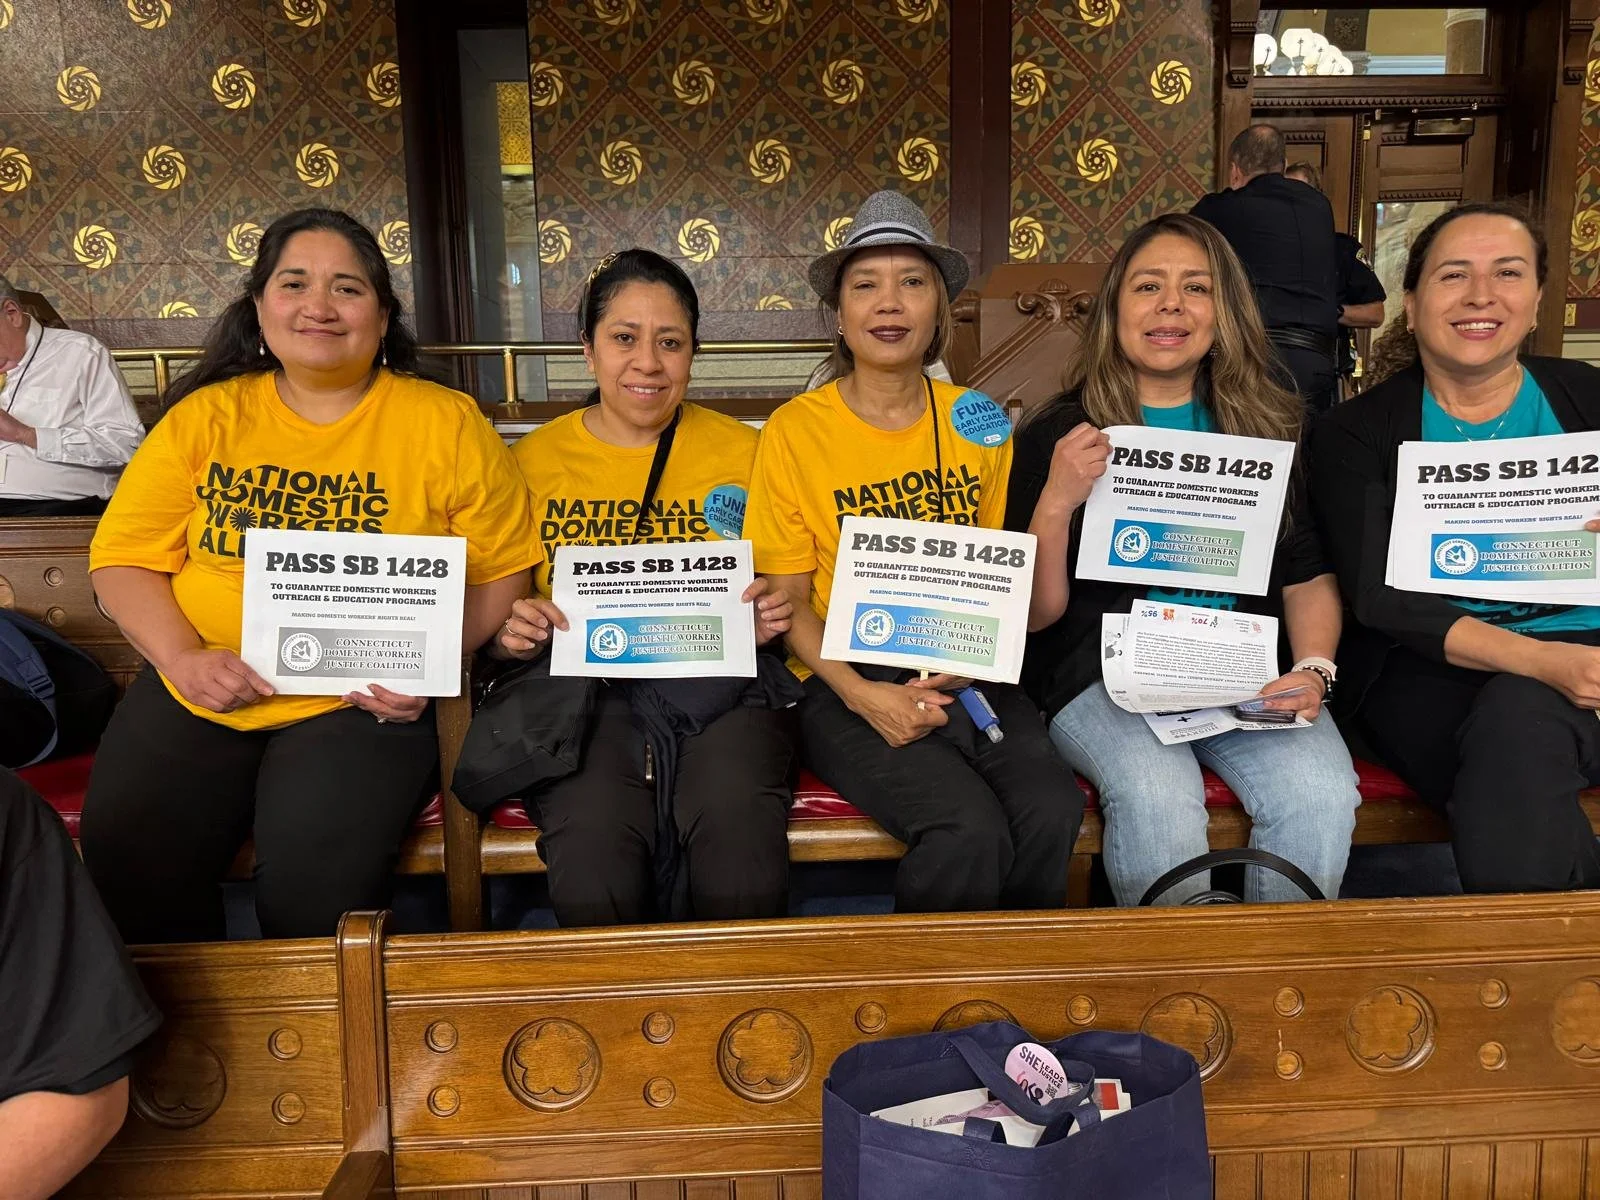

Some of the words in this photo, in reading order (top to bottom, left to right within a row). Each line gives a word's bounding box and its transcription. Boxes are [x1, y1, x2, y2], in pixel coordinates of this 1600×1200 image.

[956, 401, 996, 420] FUND
[954, 417, 980, 432] EARLY
[982, 412, 1001, 422] CARE
[964, 418, 1008, 436] EDUCATION
[1111, 446, 1174, 470] PASS
[1179, 453, 1211, 473] SB
[1216, 457, 1273, 481] 1428
[1417, 462, 1490, 484] PASS
[1498, 460, 1538, 480] SB
[1547, 454, 1599, 476] 142
[207, 462, 385, 494] NATIONAL
[833, 464, 980, 511] NATIONAL
[1113, 476, 1124, 484] TO
[1126, 477, 1175, 489] GUARANTEE
[1176, 483, 1217, 493] DOMESTIC
[1219, 487, 1259, 497] WORKERS
[1113, 487, 1156, 497] OUTREACH
[1165, 491, 1211, 502] EDUCATION
[1212, 496, 1257, 507] PROGRAMS
[1437, 491, 1496, 500] GUARANTEE
[1499, 488, 1551, 497] DOMESTIC
[1554, 484, 1600, 494] WORKER
[1487, 499, 1545, 508] EDUCATION
[1547, 495, 1600, 505] PROGRAM
[196, 486, 389, 518] DOMESTIC
[546, 499, 704, 518] NATIONAL
[540, 518, 710, 540] DOMESTIC
[1163, 532, 1231, 545] CONNECTICUT
[851, 533, 916, 554] PASS
[922, 538, 957, 558] SB
[964, 543, 1026, 568] 1428
[1152, 541, 1196, 551] DOMESTIC
[1197, 545, 1238, 556] WORKERS
[1493, 539, 1580, 549] CONNECTICUT
[266, 551, 335, 574] PASS
[343, 555, 379, 575] SB
[386, 557, 448, 578] 1428
[1150, 552, 1186, 564] JUSTICE
[1187, 556, 1235, 567] COALITION
[1480, 551, 1536, 560] DOMESTIC
[1539, 550, 1592, 558] WORKERS
[572, 560, 635, 575] PASS
[642, 559, 674, 573] SB
[681, 556, 737, 572] 1428
[866, 562, 919, 572] GUARANTEE
[920, 566, 966, 577] DOMESTIC
[968, 572, 1012, 584] WORKERS
[1482, 563, 1526, 572] JUSTICE
[1528, 562, 1590, 571] COALITION
[285, 583, 341, 592] GUARANTEE
[343, 586, 390, 594] DOMESTIC
[392, 587, 437, 596] WORKERS
[854, 570, 899, 580] OUTREACH
[909, 574, 959, 586] EDUCATION
[960, 580, 1011, 593] PROGRAMS
[272, 593, 321, 601] OUTREACH
[332, 595, 384, 604] EDUCATION
[385, 597, 436, 605] PROGRAMS
[908, 616, 984, 632] CONNECTICUT
[1141, 610, 1158, 618] 95%
[1191, 617, 1208, 625] 70%
[639, 624, 710, 632] CONNECTICUT
[896, 625, 946, 637] DOMESTIC
[946, 631, 994, 644] WORKERS
[336, 639, 412, 647] CONNECTICUT
[630, 635, 675, 643] DOMESTIC
[896, 636, 934, 648] JUSTICE
[935, 641, 990, 656] COALITION
[324, 649, 375, 657] DOMESTIC
[376, 650, 422, 658] WORKERS
[631, 646, 667, 655] JUSTICE
[324, 660, 364, 670] JUSTICE
[366, 661, 419, 669] COALITION
[1020, 1046, 1042, 1071] SHE
[1039, 1068, 1062, 1089] JUSTICE
[1041, 1062, 1064, 1083] LEADS
